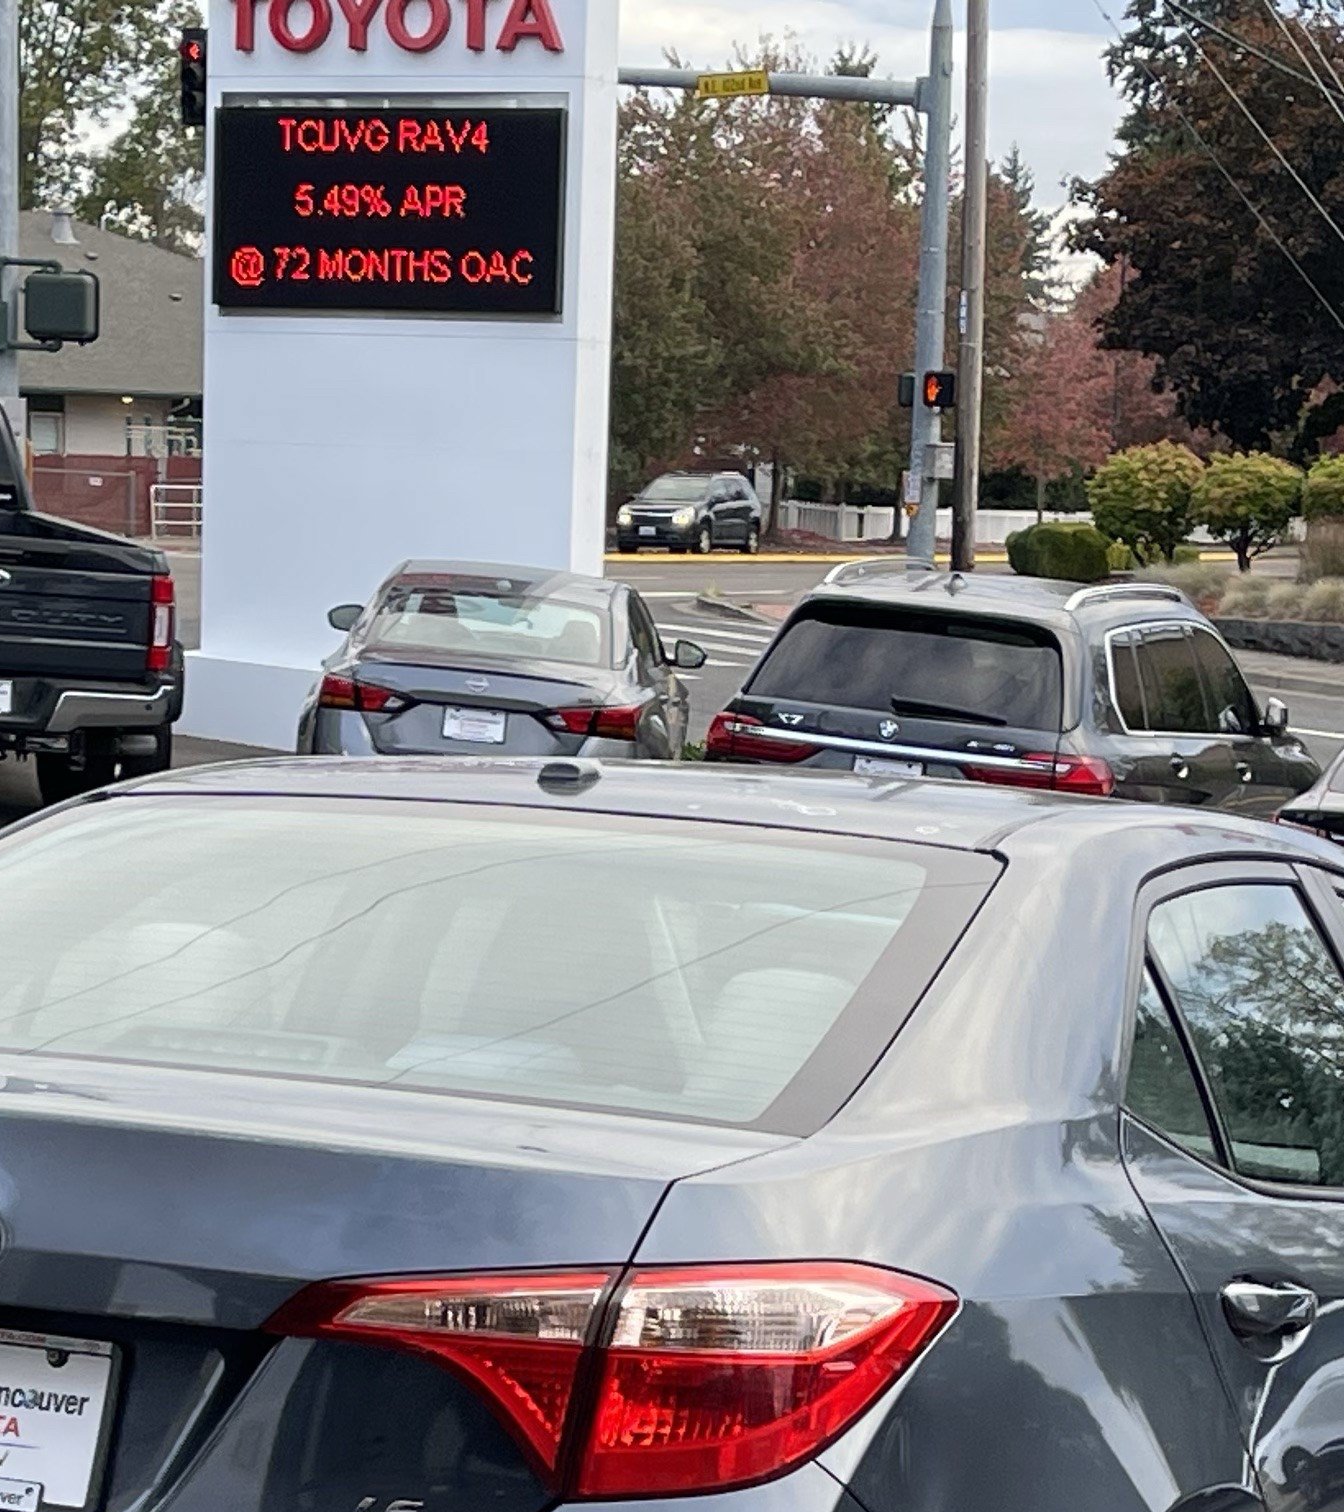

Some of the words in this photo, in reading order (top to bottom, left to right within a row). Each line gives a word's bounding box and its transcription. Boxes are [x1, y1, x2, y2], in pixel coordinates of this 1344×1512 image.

[232, 0, 564, 53] TOYOTA
[398, 119, 489, 154] RAV4
[293, 184, 392, 218] 5.49%
[399, 185, 467, 218] APR
[230, 247, 265, 286] @
[273, 247, 310, 281] 72
[317, 248, 452, 283] MONTHS
[460, 249, 534, 284] OAC
[10, 608, 124, 624] DUTY
